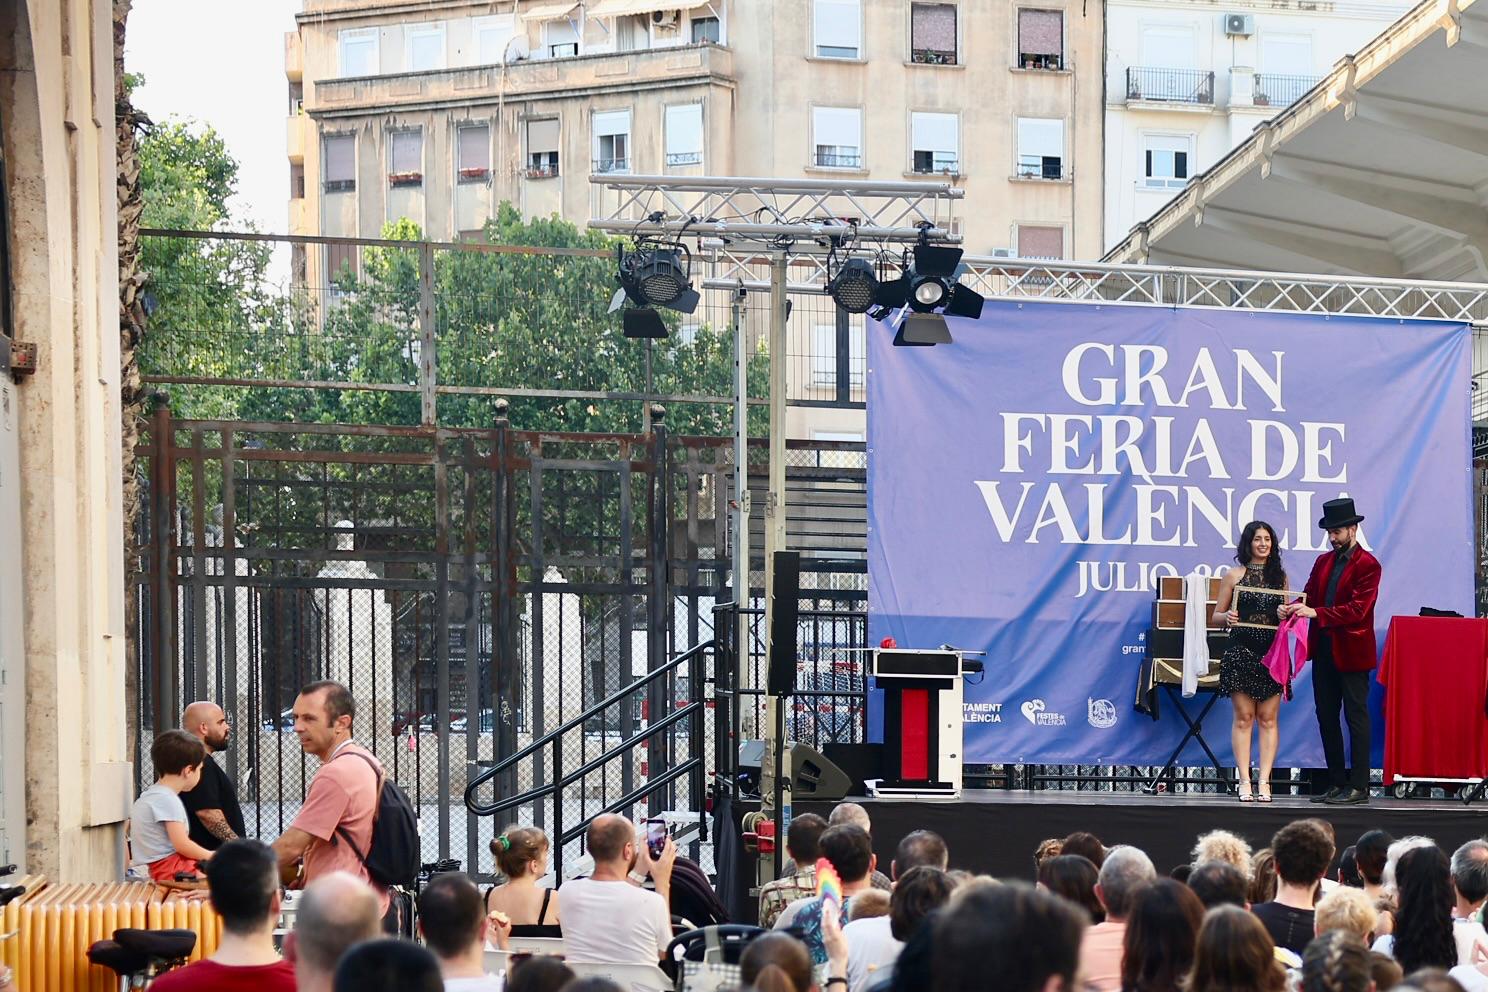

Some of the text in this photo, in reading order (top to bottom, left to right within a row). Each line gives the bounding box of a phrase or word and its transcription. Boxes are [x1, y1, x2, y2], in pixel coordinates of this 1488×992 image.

[1061, 342, 1286, 413] GRAN
[999, 412, 1348, 484] FERIA DE
[1121, 645, 1147, 655] gran
[962, 702, 1003, 712] TAMENT
